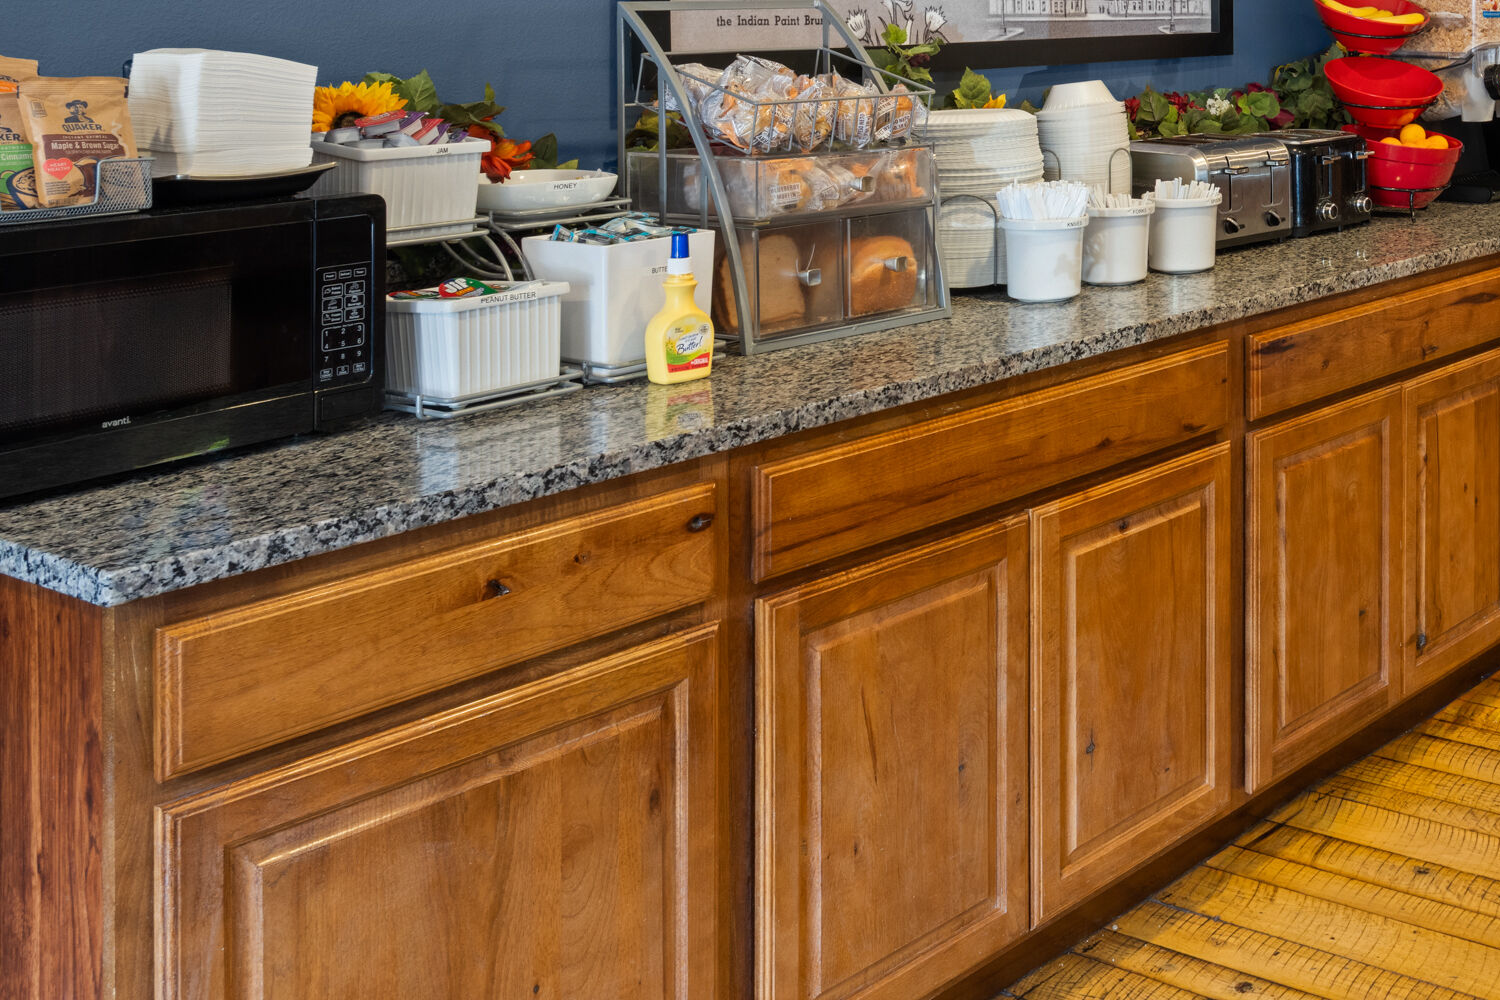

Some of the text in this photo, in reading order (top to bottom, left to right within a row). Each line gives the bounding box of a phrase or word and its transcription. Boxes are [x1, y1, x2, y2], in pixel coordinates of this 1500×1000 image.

[716, 14, 823, 27] the Indian Paint Bru
[62, 124, 103, 133] QUAKER
[0, 133, 21, 141] KER
[51, 141, 74, 150] Maple
[82, 141, 102, 149] Brown
[103, 142, 120, 151] Sugar
[553, 182, 577, 190] HONEY
[651, 266, 668, 274] BUTTE
[480, 291, 537, 304] PEANUT BUTTER
